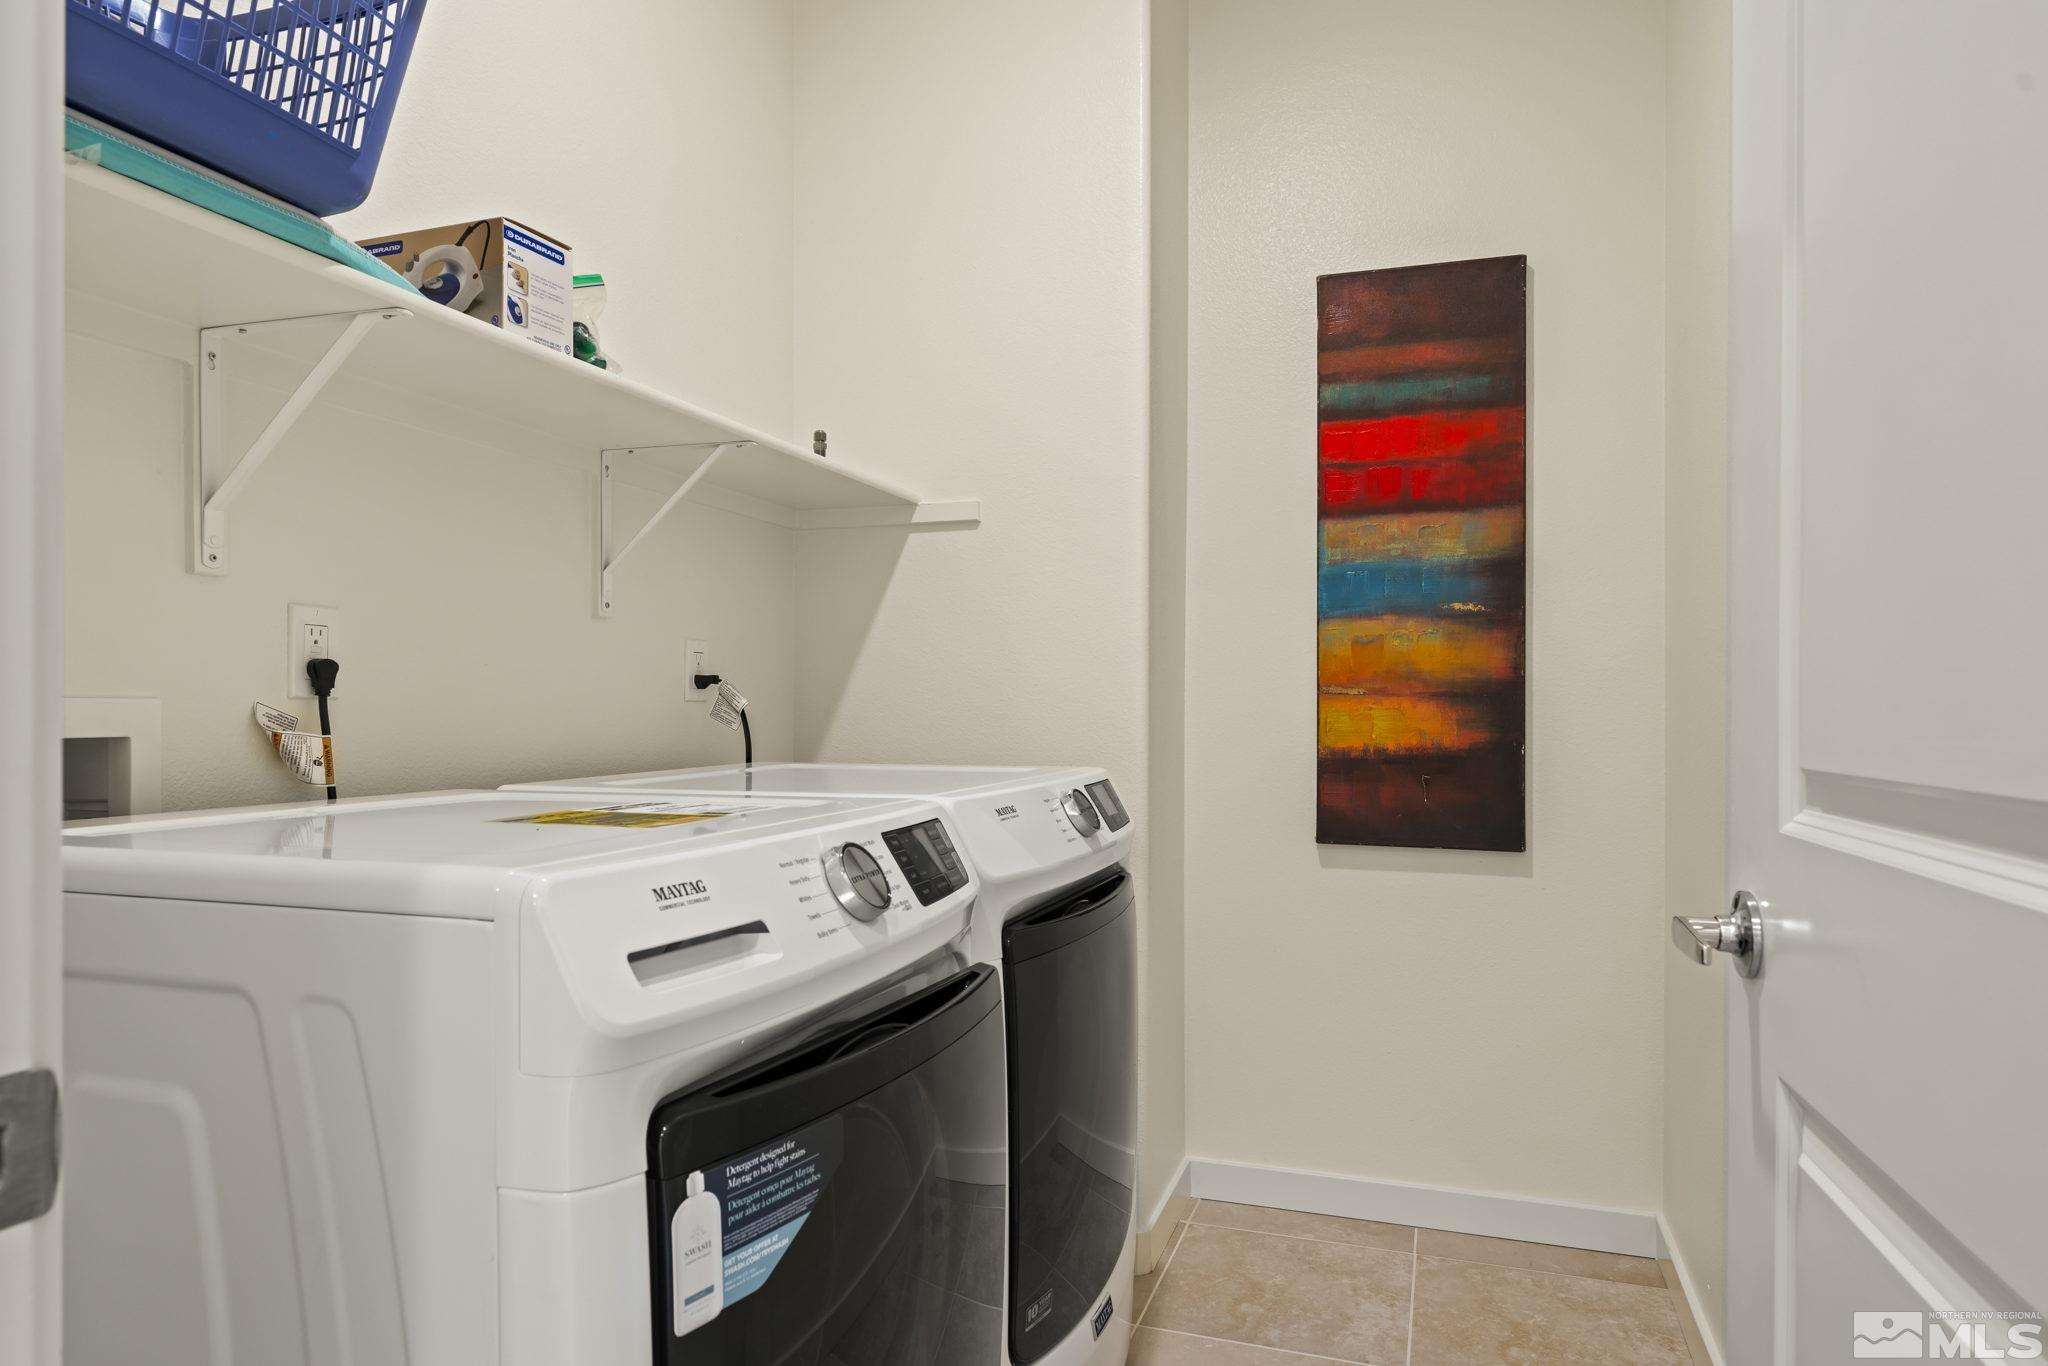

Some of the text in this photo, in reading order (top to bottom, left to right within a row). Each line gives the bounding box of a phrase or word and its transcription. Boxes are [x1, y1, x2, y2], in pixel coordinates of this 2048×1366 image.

[368, 244, 401, 254] ABRAND
[514, 234, 563, 261] DURABRAND
[995, 805, 1017, 816] MAYTAG
[851, 874, 866, 884] EXTRA
[865, 869, 880, 878] POWER
[651, 880, 707, 902] MAYTAG
[727, 1140, 795, 1177] Detergent designed for
[727, 1148, 806, 1190] Maytag to help fight stains
[779, 1174, 793, 1189] pour
[794, 1164, 815, 1179] Maytag
[728, 1210, 744, 1227] pour
[745, 1203, 760, 1217] aider
[766, 1186, 795, 1205] combattre
[796, 1182, 804, 1192] les
[804, 1174, 821, 1186] taches
[684, 1240, 712, 1258] SWASH
[724, 1257, 736, 1268] GET
[737, 1248, 753, 1261] YOUR
[754, 1239, 771, 1253] OFFER
[772, 1234, 779, 1243] AT
[1027, 1304, 1039, 1322] 10
